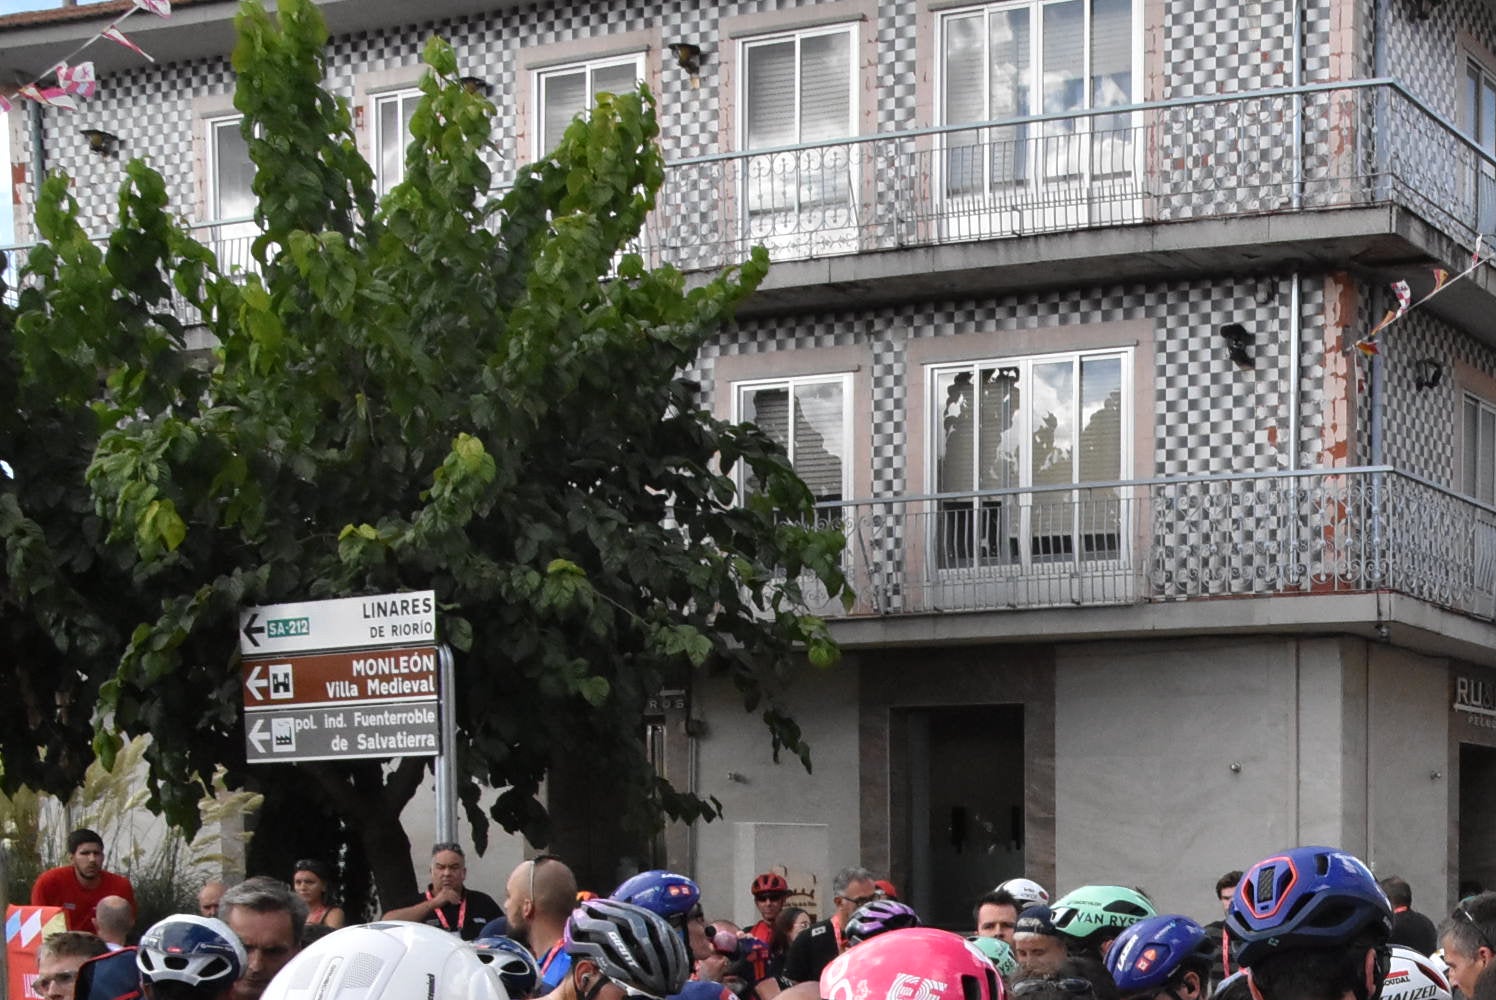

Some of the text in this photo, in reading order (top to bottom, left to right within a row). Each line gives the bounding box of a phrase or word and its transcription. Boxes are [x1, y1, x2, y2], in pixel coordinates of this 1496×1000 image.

[363, 598, 432, 618] LINARES
[267, 619, 308, 637] SA-212
[370, 621, 433, 638] DE RIORÍO
[352, 652, 434, 676] MONLEÓN
[326, 675, 435, 698] Villa Medieval
[324, 713, 347, 728] ind.
[354, 709, 435, 726] Fuenterroble
[331, 733, 435, 750] de Salvatierra
[1076, 912, 1103, 924] VAN
[608, 931, 640, 969] GIANT
